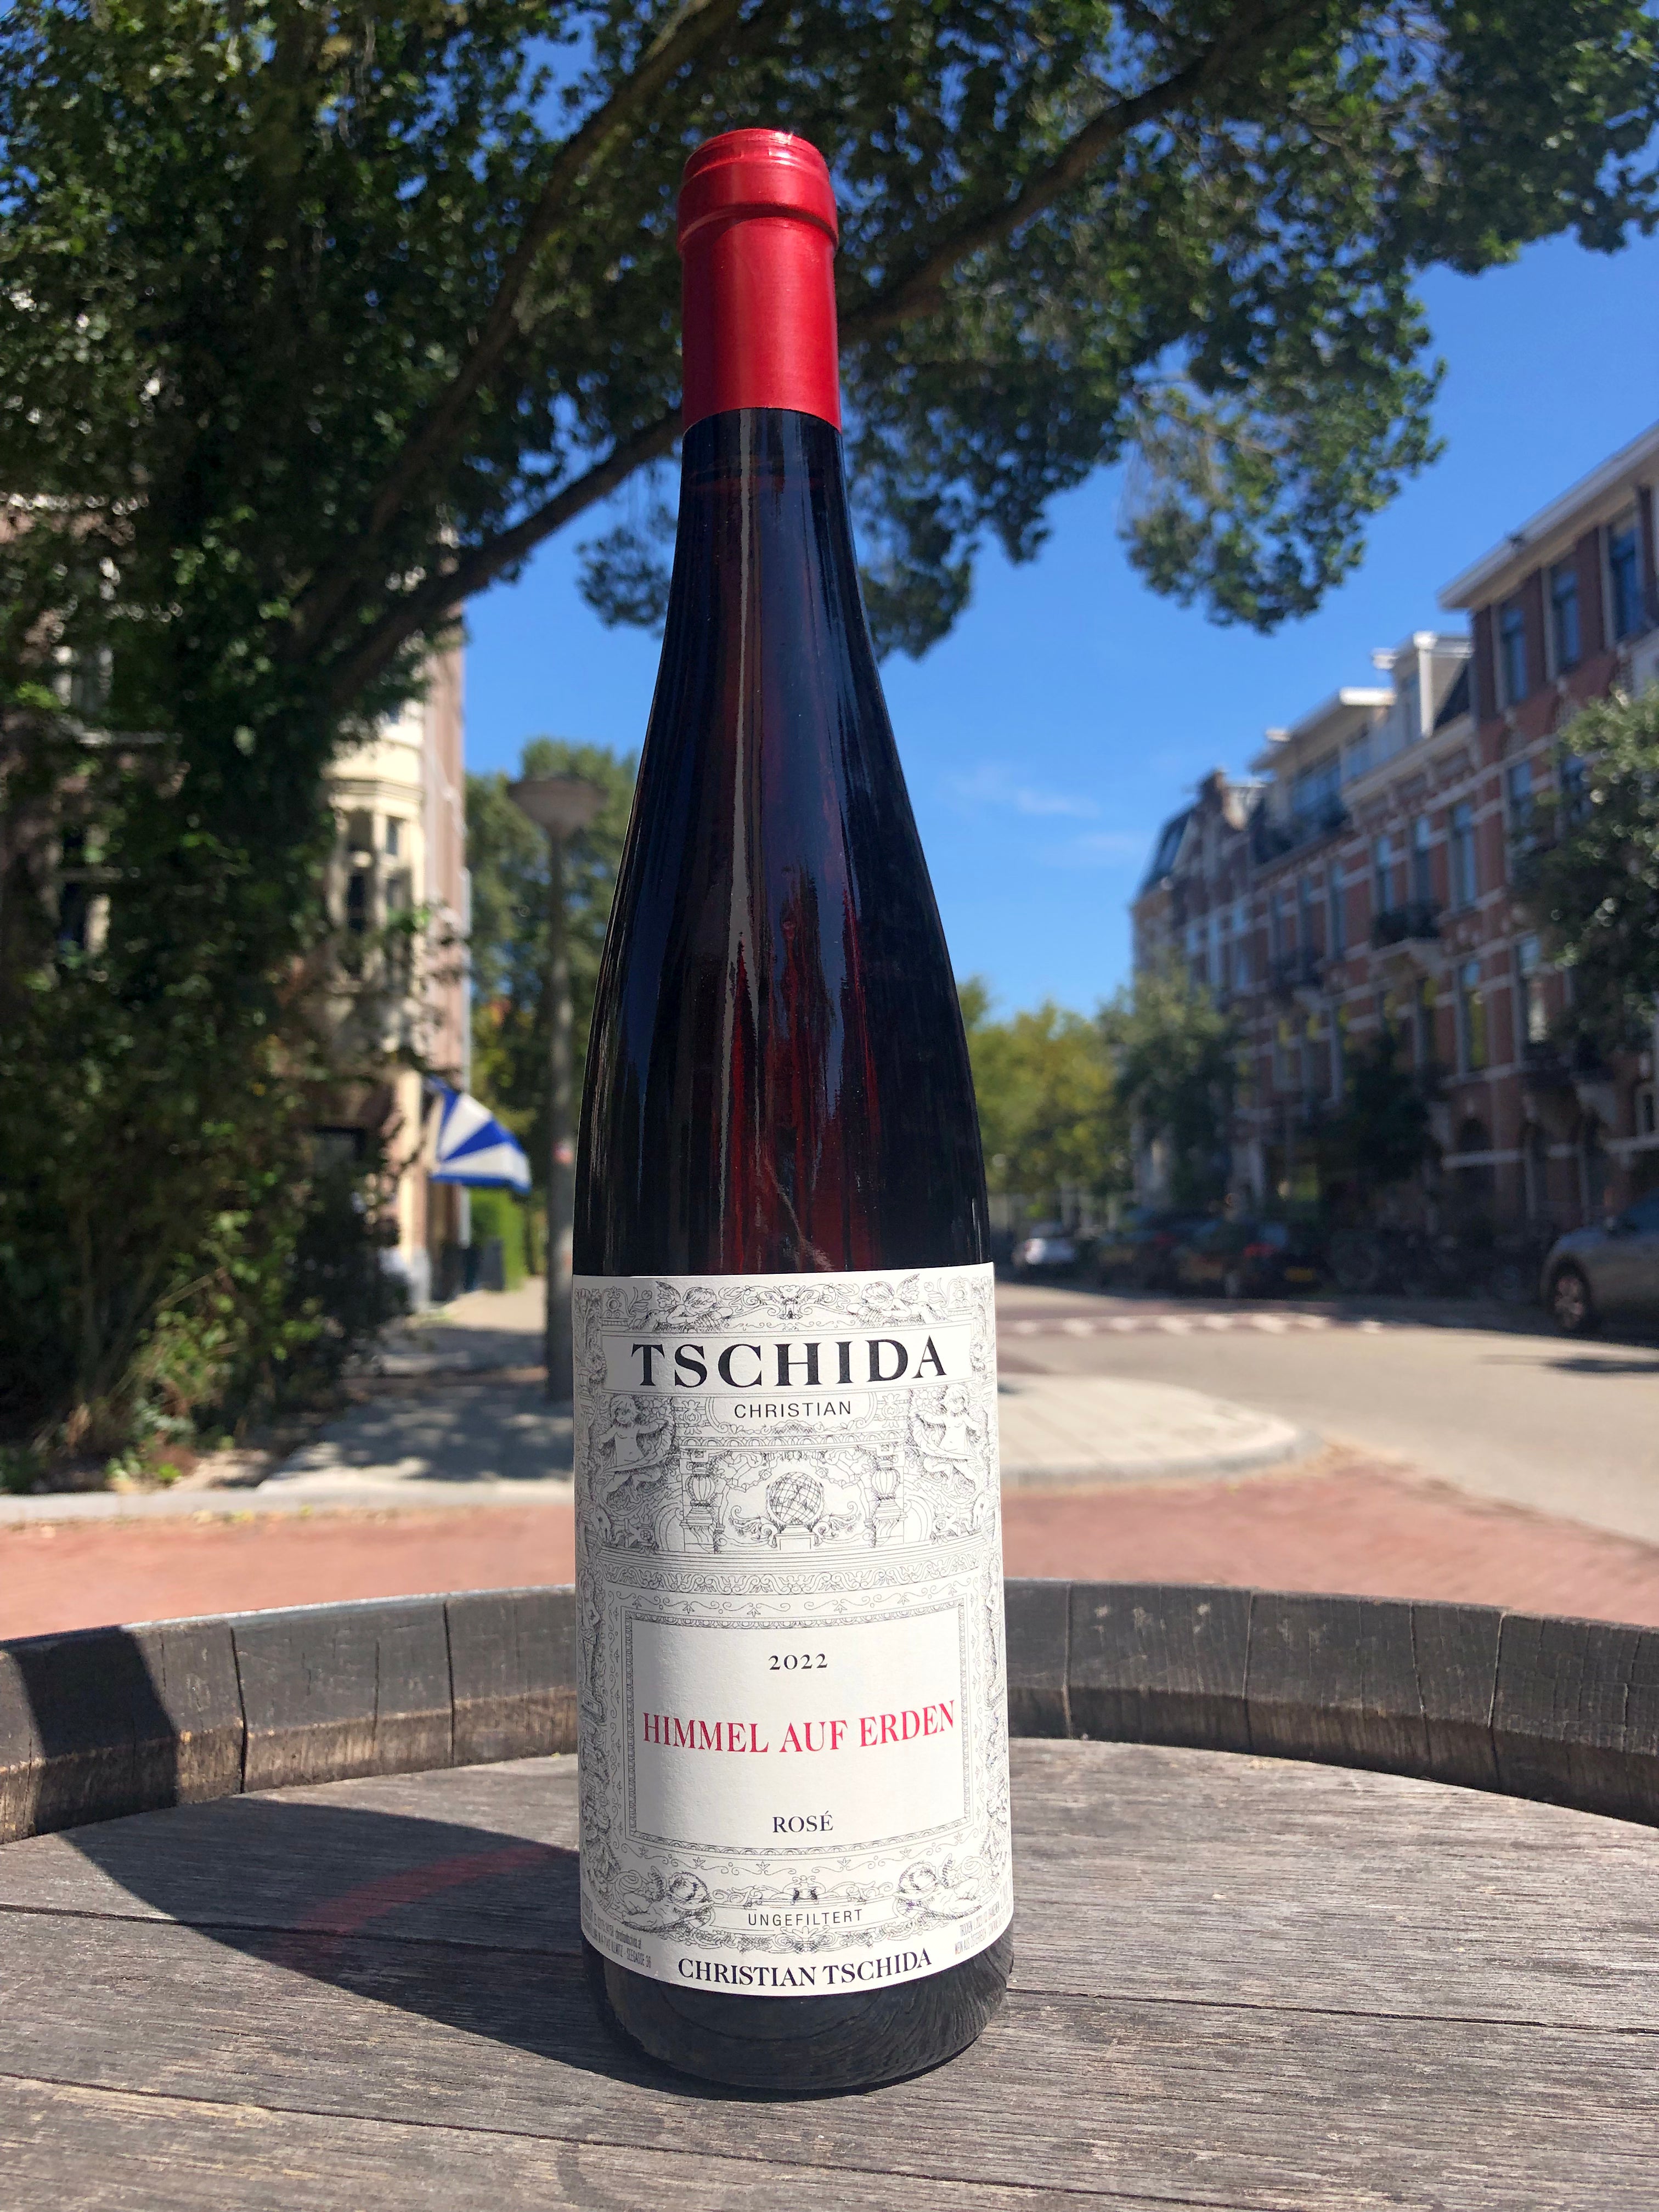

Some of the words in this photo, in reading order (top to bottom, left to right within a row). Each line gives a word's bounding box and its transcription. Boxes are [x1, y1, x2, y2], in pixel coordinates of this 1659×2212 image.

[631, 1335, 947, 1388] TSCHIDA
[734, 1401, 851, 1419] CHRISTIAN
[768, 1653, 828, 1671] 2022
[643, 1712, 769, 1753] HIMMEL
[778, 1720, 848, 1753] AUF
[859, 1700, 956, 1747] ERDEN
[772, 1810, 833, 1833] ROSÉ
[748, 1909, 862, 1926] UNGEFILTERT
[678, 1957, 817, 1987] CHRISTIAN
[822, 1948, 933, 1985] TSCHIDA
